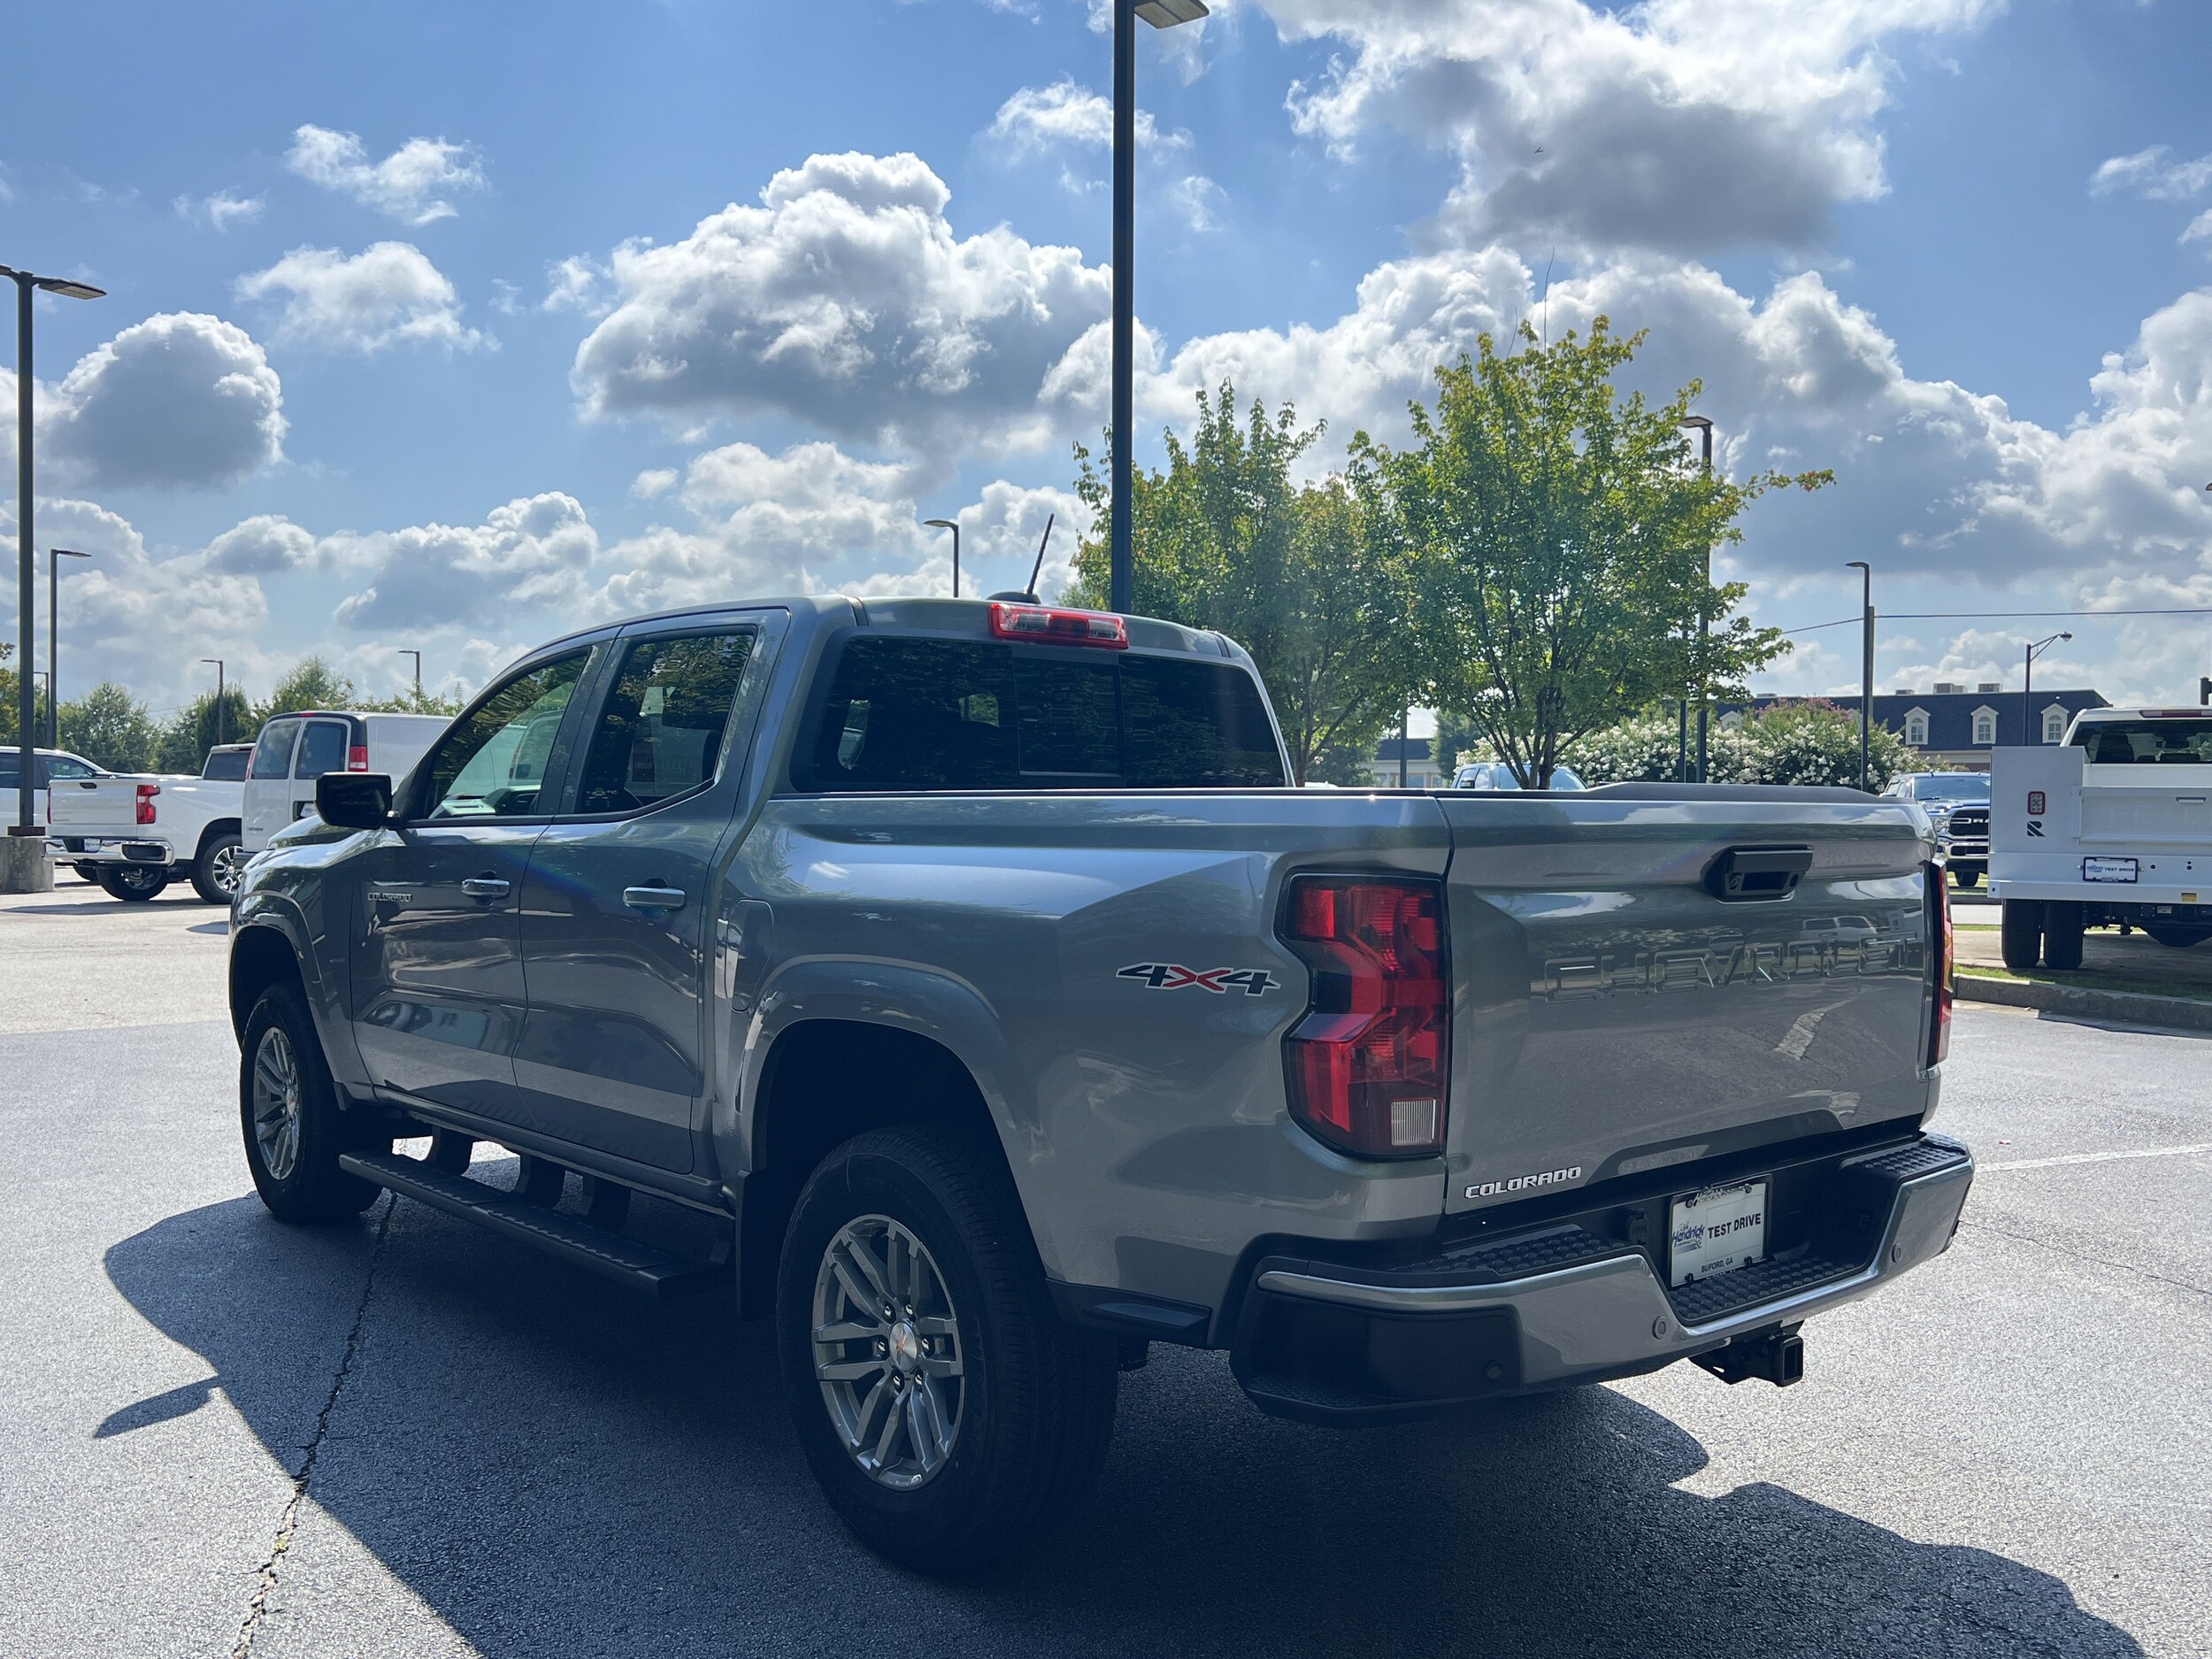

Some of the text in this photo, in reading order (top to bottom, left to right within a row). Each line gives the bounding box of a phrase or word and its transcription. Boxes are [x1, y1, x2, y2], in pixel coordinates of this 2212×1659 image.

[1545, 931, 1917, 1004] CHEVROLET
[1464, 1166, 1582, 1199] COLORADO
[1671, 1225, 1705, 1248] Hendrick
[1708, 1222, 1732, 1239] TEST
[1733, 1213, 1762, 1232] DRIVE
[1725, 1256, 1733, 1265] GA
